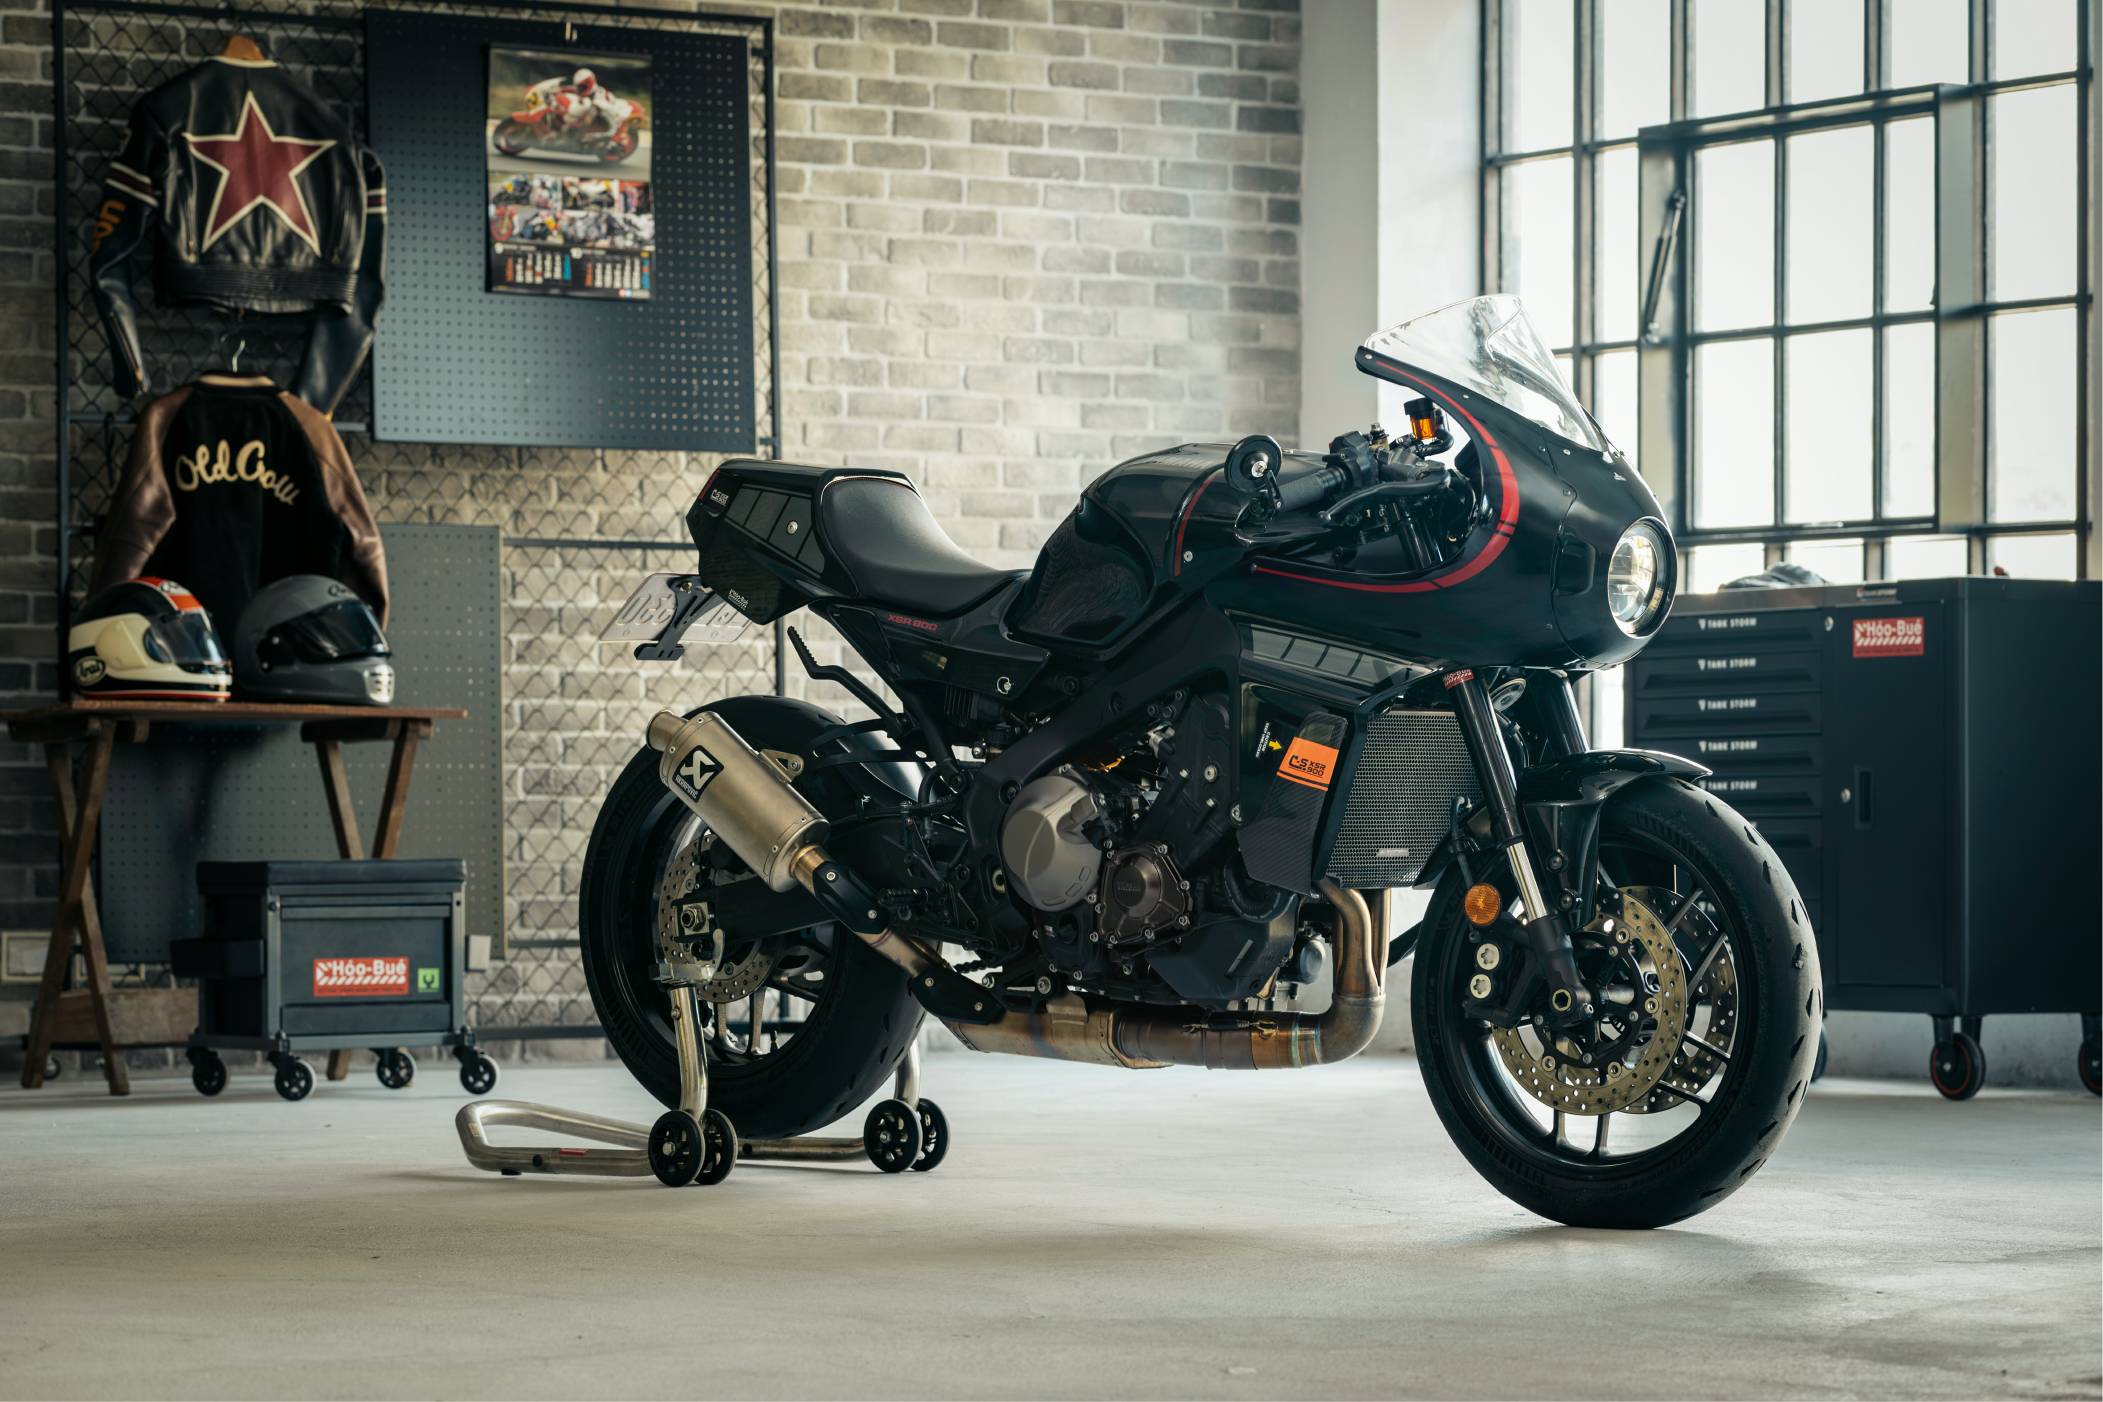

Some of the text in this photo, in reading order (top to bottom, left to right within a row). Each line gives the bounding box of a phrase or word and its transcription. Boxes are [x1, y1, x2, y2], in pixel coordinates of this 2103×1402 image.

[174, 438, 239, 492] Old
[887, 613, 938, 631] XSR 900
[1707, 617, 1757, 629] TANK STORM
[1866, 618, 1922, 637] Hóo-Bué
[77, 659, 104, 680] Arai
[1707, 657, 1757, 670] TANK STORM
[1707, 698, 1757, 710] TANK STORM
[1707, 740, 1758, 751] TANK STORM
[1307, 767, 1324, 777] 900
[1309, 760, 1327, 771] XSR
[1707, 780, 1758, 791] TANK STORM
[331, 958, 407, 977] Hóo-Bué
[1428, 987, 1436, 1015] FRONT
[1631, 1167, 1672, 1189] POWER
